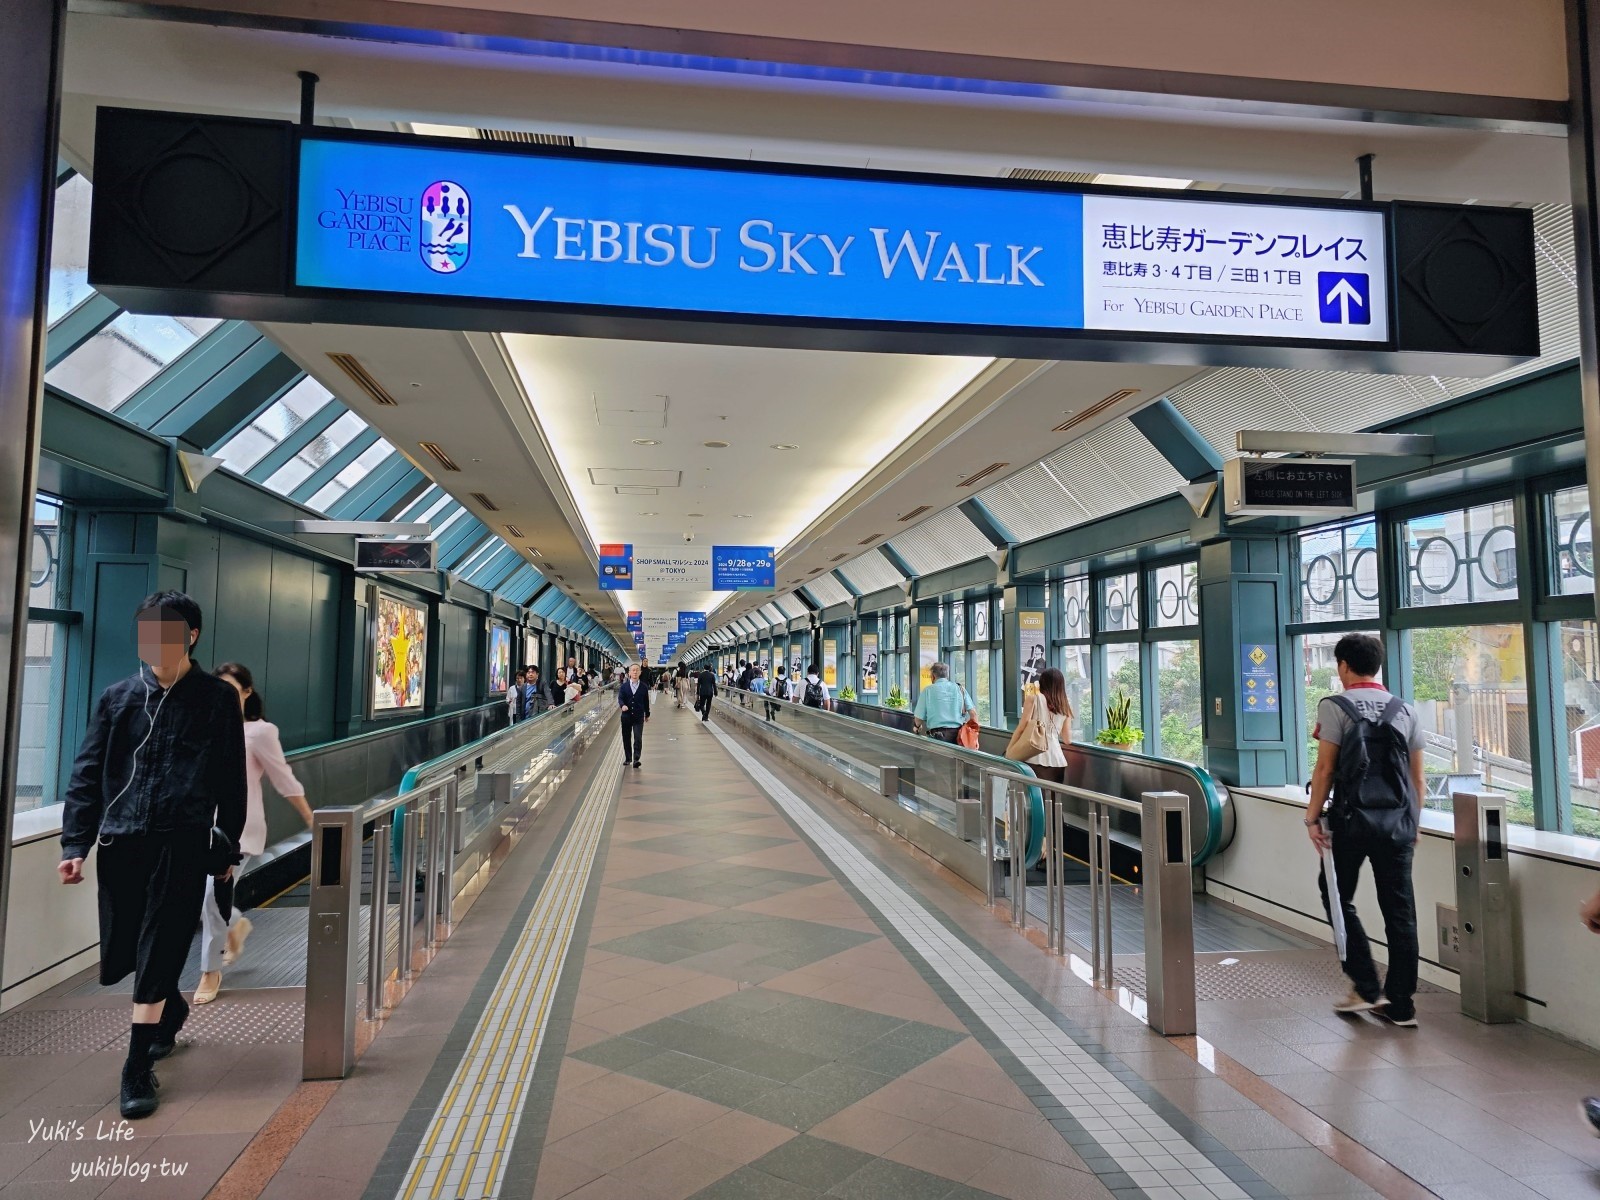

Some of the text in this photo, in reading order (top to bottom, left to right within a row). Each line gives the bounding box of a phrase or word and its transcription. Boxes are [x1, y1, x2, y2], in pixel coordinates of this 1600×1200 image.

[336, 188, 413, 215] YEBISU
[317, 210, 413, 233] GARDEN
[347, 231, 411, 252] PLACE
[502, 204, 1045, 287] YEBISU SKY WALK
[1101, 223, 1367, 262] 恵比寿ガーデンプレイス
[1103, 297, 1303, 321] For YEBISU GARDEN PLACE
[1254, 470, 1343, 481] 左側にお立ち下さい
[1254, 489, 1343, 499] PLEASE STAND ON THE LEFT SIDE
